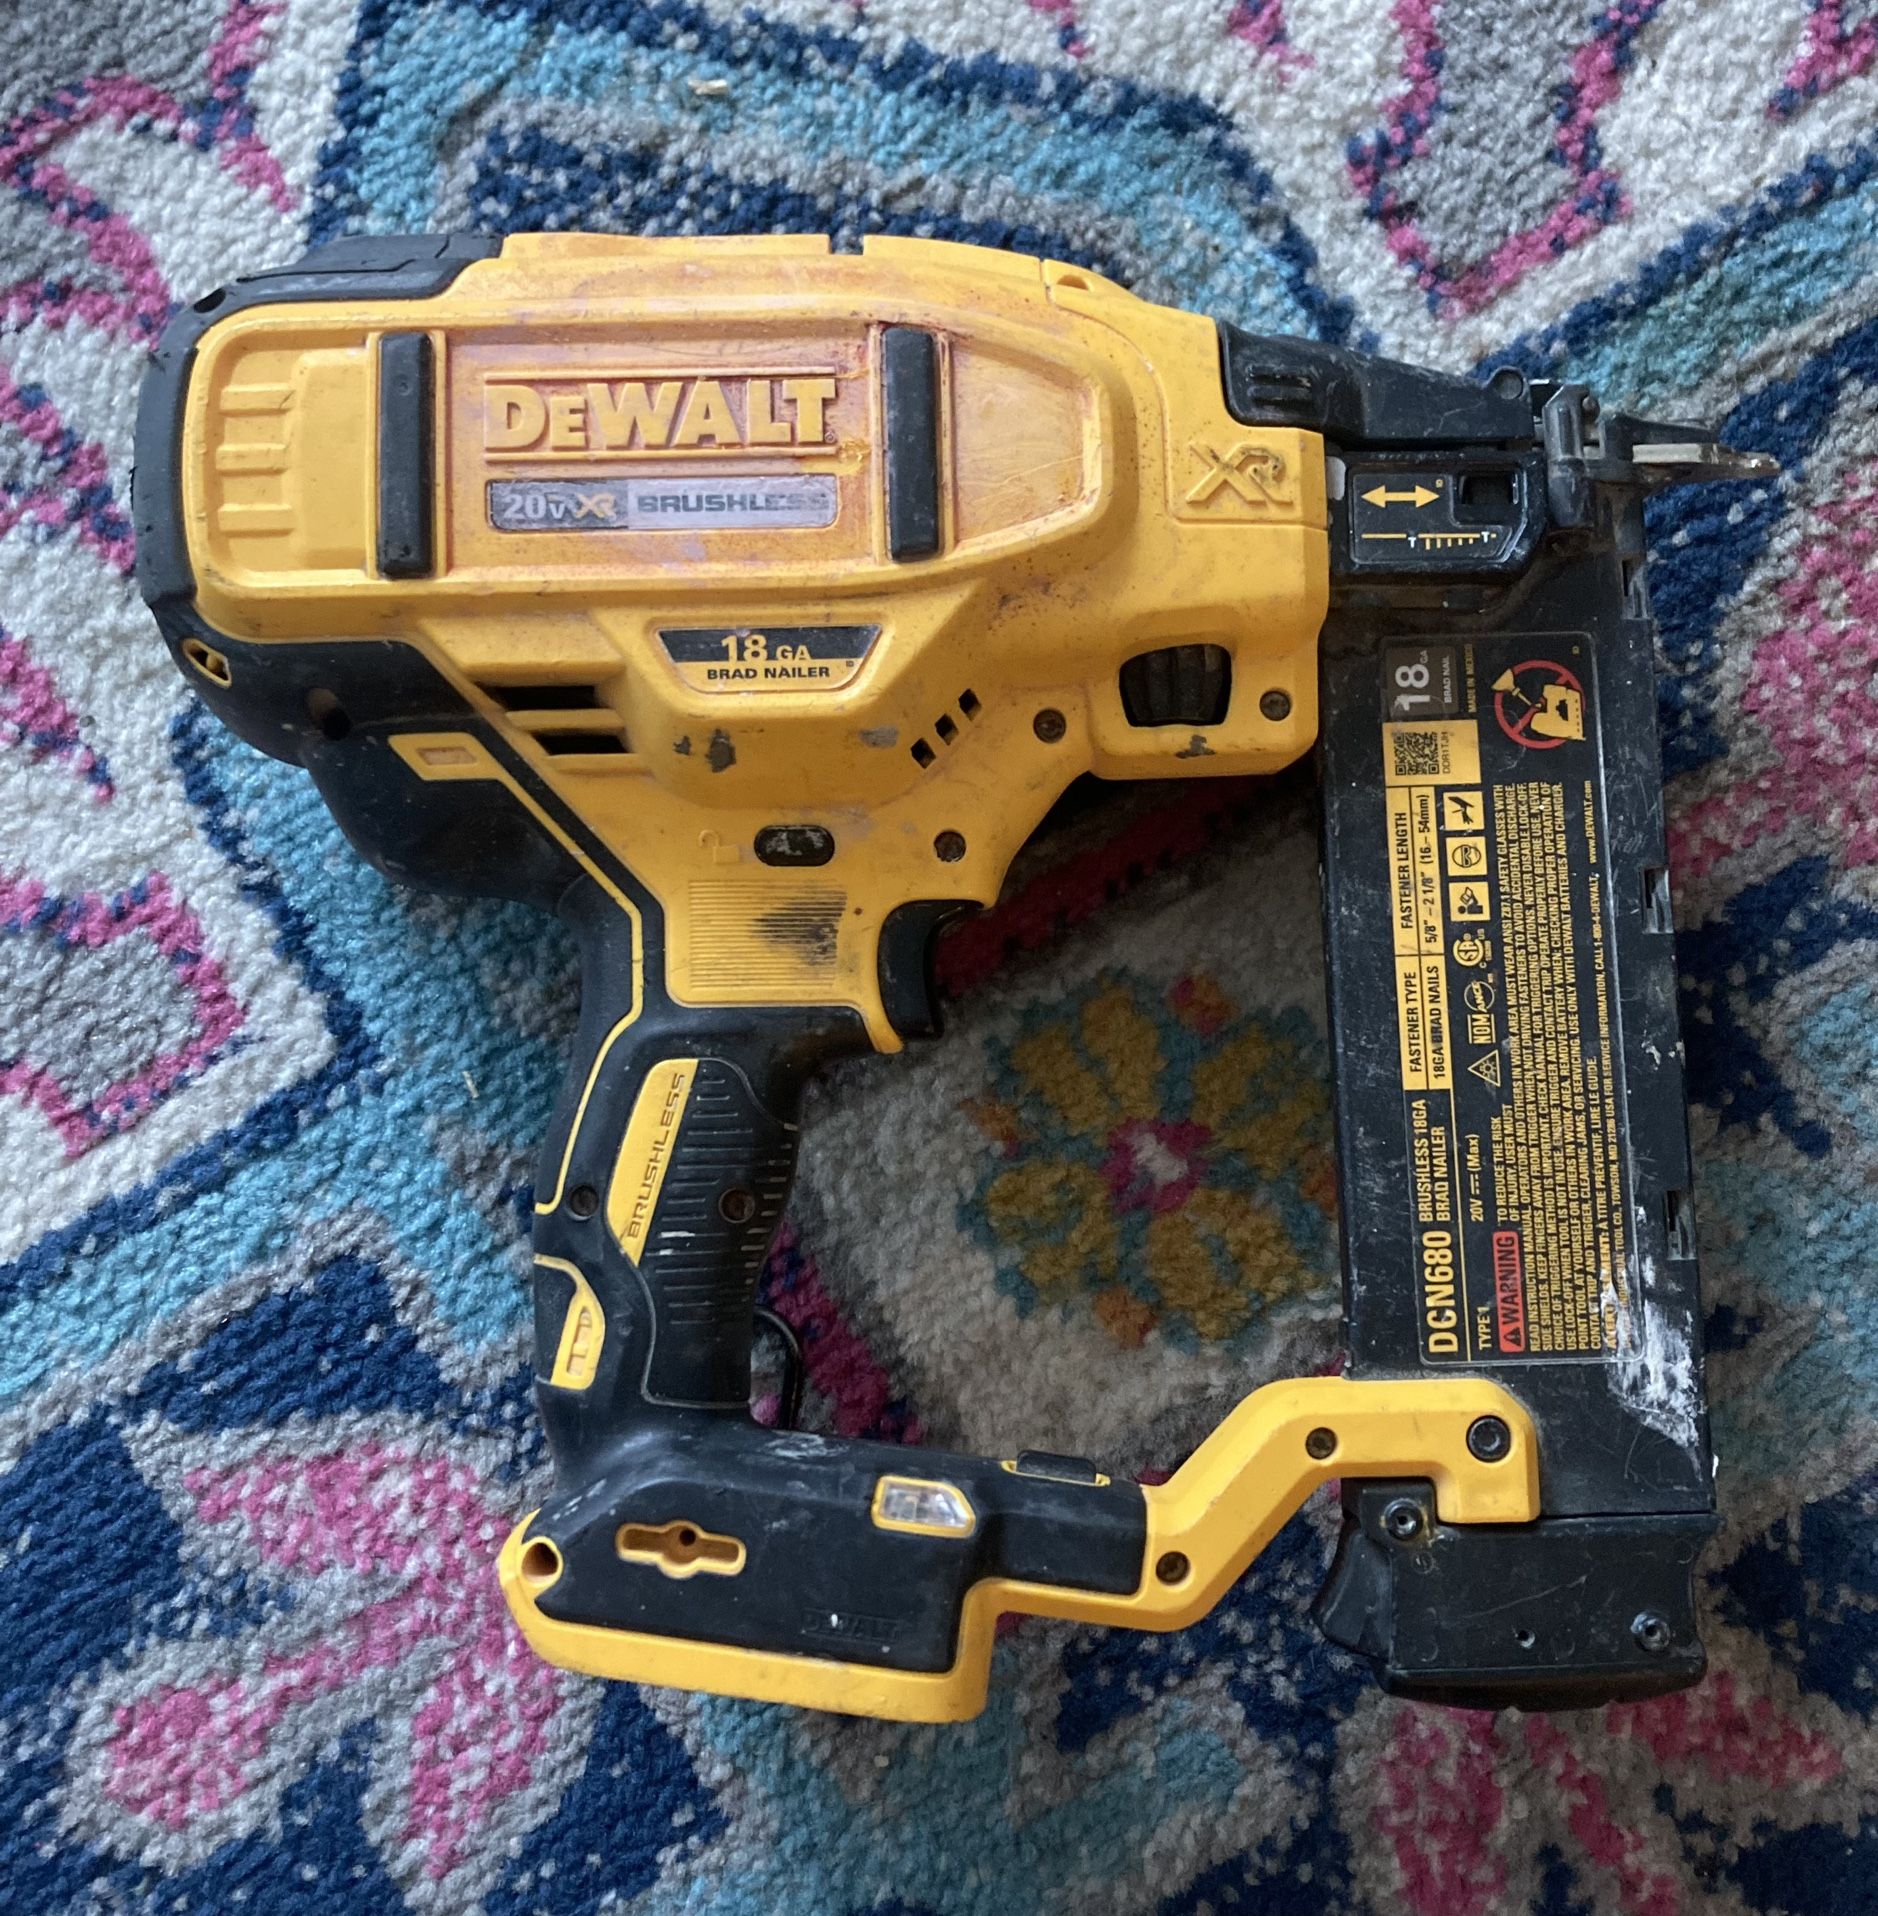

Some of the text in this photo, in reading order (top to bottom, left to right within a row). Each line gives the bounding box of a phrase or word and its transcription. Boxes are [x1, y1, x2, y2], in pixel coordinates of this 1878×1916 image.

[484, 379, 836, 449] DEWALT
[1186, 441, 1293, 505] XR
[637, 492, 830, 513] BRUSHLESS
[721, 634, 812, 662] 18 GA
[707, 666, 830, 680] BRAD NAILER
[1393, 663, 1431, 711] 18
[1441, 655, 1452, 703] BRAD NAIL
[1463, 643, 1476, 712] MADE IN MEXICO
[1493, 784, 1504, 809] WITH
[1528, 782, 1540, 812] NEVER
[1540, 781, 1551, 794] OF
[1495, 812, 1507, 854] GLASSES
[1541, 797, 1555, 852] OPERATION
[1582, 780, 1597, 863] www.DEWALT.com
[1520, 830, 1532, 871] DISABLE
[1532, 838, 1544, 873] BEFORE
[1555, 833, 1567, 855] AND
[1394, 812, 1412, 928] FASTENER LENGTH
[1498, 856, 1510, 892] SAFETY
[1508, 841, 1522, 900] ACCIDENTAL
[1545, 855, 1557, 894] PROPER
[1557, 858, 1571, 910] BATTERIES
[1522, 873, 1534, 904] NEVER
[1534, 875, 1547, 923] PROPERLY
[1502, 919, 1513, 943] ANSI
[1512, 902, 1524, 931] AVOID
[1548, 896, 1561, 947] CHECKING
[1514, 934, 1525, 946] TO
[1538, 925, 1550, 967] OPERATE
[1561, 912, 1574, 953] DEWALT
[1503, 946, 1515, 975] WEAR
[1564, 956, 1576, 982] WITH
[1594, 948, 1604, 969] CALL
[1505, 977, 1517, 1004] MUST
[1515, 948, 1529, 1003] FASTENERS
[1528, 954, 1541, 1012] TRIGGERING
[1541, 970, 1552, 990] TRIP
[1470, 979, 1487, 1013] ANCE
[1554, 986, 1567, 1030] BATTERY
[1566, 985, 1578, 1011] ONLY
[1403, 971, 1421, 1072] FASTENER TYPE
[1426, 965, 1445, 1078] 18GA BRAD NAILS
[1471, 1013, 1491, 1044] NOM
[1507, 1008, 1519, 1033] AREA
[1519, 1006, 1532, 1045] DRIVING
[1532, 1015, 1543, 1033] FOR
[1542, 993, 1555, 1037] CONTACT
[1568, 1013, 1579, 1033] USE
[1509, 1035, 1521, 1065] WORK
[1522, 1048, 1533, 1068] NOT
[1533, 1035, 1546, 1079] MANUAL
[1545, 1039, 1557, 1061] AND
[1557, 1033, 1570, 1075] REMOVE
[1569, 1036, 1583, 1092] SERVICING.
[1600, 1039, 1612, 1076] SERVICE
[1511, 1068, 1522, 1078] IN
[1524, 1071, 1536, 1101] WHEN
[1547, 1063, 1560, 1103] TRIGGER
[1603, 1078, 1613, 1095] FOR
[1512, 1081, 1525, 1118] OTHERS
[1536, 1081, 1548, 1113] CHECK
[1573, 1095, 1585, 1109] OR
[1589, 1092, 1599, 1104] LE
[1604, 1097, 1615, 1116] USA
[1502, 1103, 1513, 1133] MUST
[1515, 1121, 1526, 1143] AND
[1526, 1103, 1538, 1144] TRIGGER
[1550, 1106, 1563, 1145] ENSURE
[1562, 1110, 1574, 1142] WORK
[1590, 1106, 1601, 1128] LIRE
[627, 1072, 685, 1239] BRUSHLESS
[1411, 1099, 1433, 1222] BRUSHLESS 18GA
[1504, 1135, 1515, 1162] USER
[1529, 1147, 1541, 1175] FROM
[1565, 1145, 1575, 1155] IN
[1608, 1144, 1618, 1159] MD
[1430, 1126, 1451, 1221] BRAD NAILER
[1465, 1133, 1484, 1221] 20V (Max)
[1491, 1116, 1507, 1221] TO REDUCE THE RISK
[1517, 1145, 1530, 1203] OPERATORS
[1543, 1178, 1553, 1188] IS
[1554, 1172, 1565, 1183] IN
[1566, 1158, 1578, 1198] OTHERS
[1577, 1147, 1591, 1197] CLEARING
[1531, 1178, 1543, 1207] AWAY
[1555, 1185, 1567, 1205] NOT
[1568, 1201, 1580, 1215] OR
[1595, 1191, 1607, 1219] TITRE
[1509, 1207, 1519, 1221] OF
[1544, 1191, 1556, 1233] METHOD
[1557, 1209, 1567, 1218] IS
[1533, 1209, 1546, 1251] FINGERS
[1558, 1220, 1569, 1245] TOOL
[1570, 1217, 1583, 1269] YOURSELF
[1613, 1226, 1624, 1250] TOOL
[1536, 1254, 1547, 1279] KEEP
[1547, 1236, 1560, 1295] TRIGGERING
[1560, 1248, 1572, 1278] WHEN
[1584, 1249, 1596, 1271] AND
[1421, 1229, 1458, 1352] DCN680
[1496, 1236, 1520, 1324] WARNING
[1524, 1254, 1538, 1321] INSTRUCTION
[1573, 1273, 1584, 1285] AT
[1586, 1275, 1598, 1298] TRIP
[1551, 1297, 1562, 1311] OF
[1562, 1281, 1575, 1327] LOCK-OFF
[1574, 1288, 1586, 1313] TOOL
[1477, 1314, 1492, 1350] TYPE
[1528, 1324, 1540, 1350] READ
[1540, 1327, 1552, 1350] SIDE
[1552, 1313, 1564, 1350] CHOICE
[1565, 1330, 1576, 1349] USE
[1576, 1317, 1589, 1349] POINT
